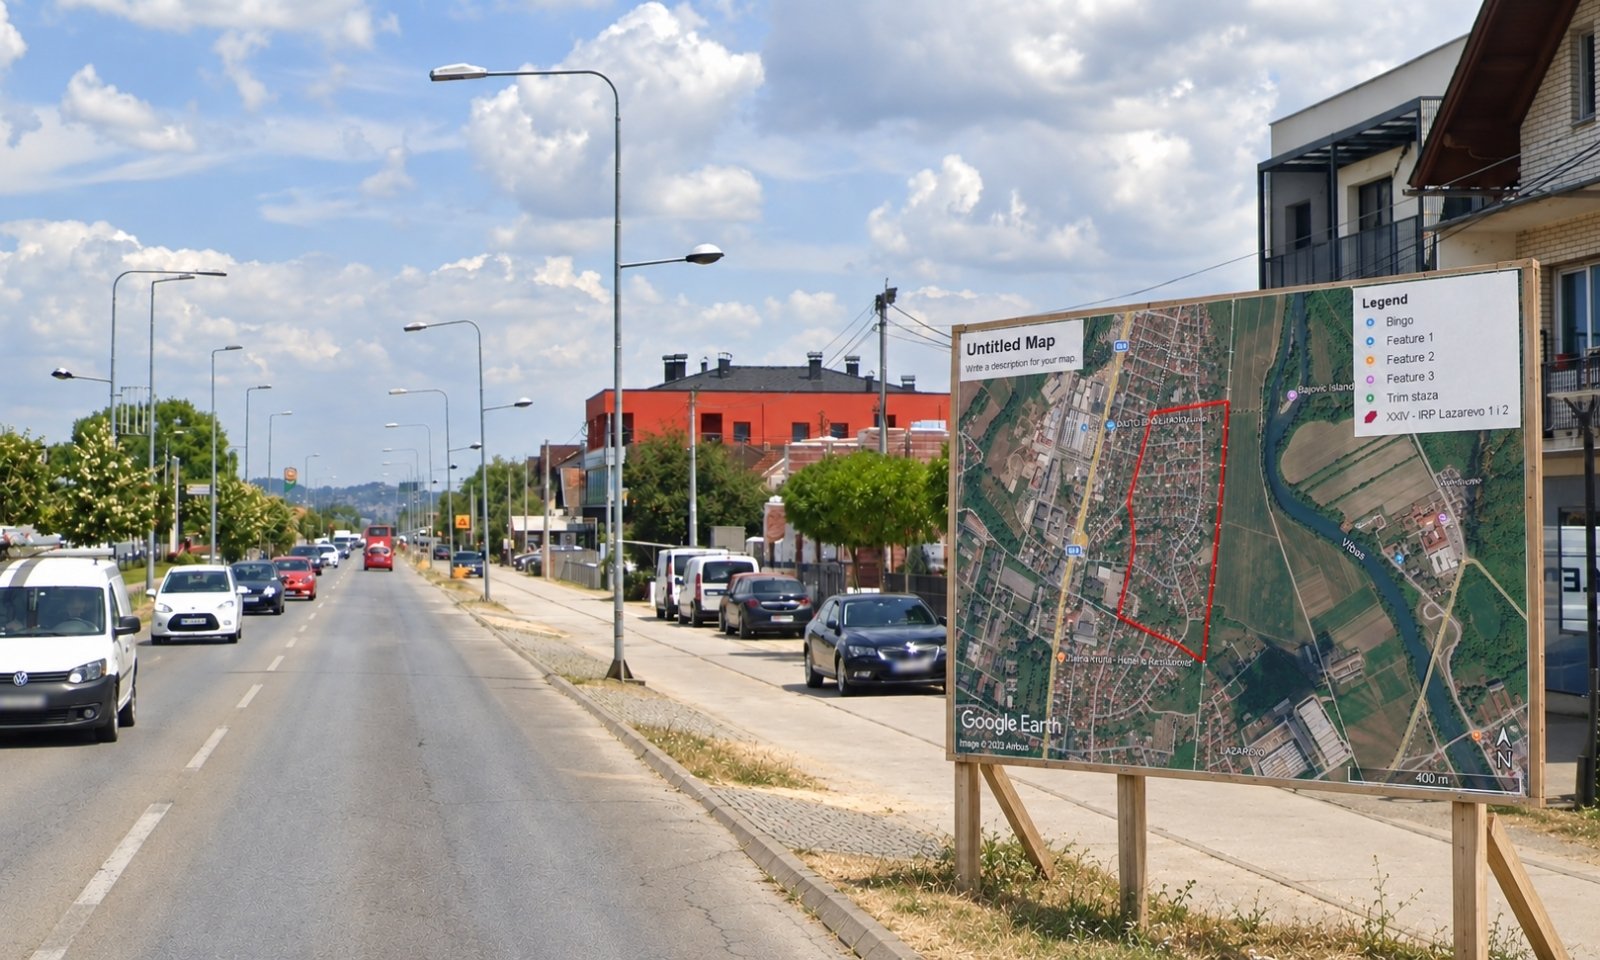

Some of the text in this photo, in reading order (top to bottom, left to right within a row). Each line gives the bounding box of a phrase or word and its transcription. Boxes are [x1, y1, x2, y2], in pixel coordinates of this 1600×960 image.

[1362, 293, 1408, 310] Legend
[1386, 316, 1414, 328] Bingo
[966, 335, 1056, 356] Untitled Map
[1386, 332, 1433, 346] Feature 1
[965, 364, 983, 373] Write
[991, 359, 1029, 371] description
[1030, 358, 1040, 366] for
[1041, 356, 1057, 367] your
[1386, 351, 1435, 365] Feature 2
[1386, 371, 1435, 384] Feature 3
[1329, 381, 1355, 392] Island
[1387, 391, 1439, 403] Trim staza
[1386, 411, 1410, 421] XXIV
[1418, 409, 1436, 420] IRP
[1439, 407, 1485, 419] Lazarevo
[1489, 406, 1493, 416] 1
[1502, 404, 1509, 415] 2
[961, 709, 1062, 736] Google Earth
[959, 739, 979, 750] Image
[1497, 750, 1512, 769] N
[1415, 772, 1449, 784] 400 m
